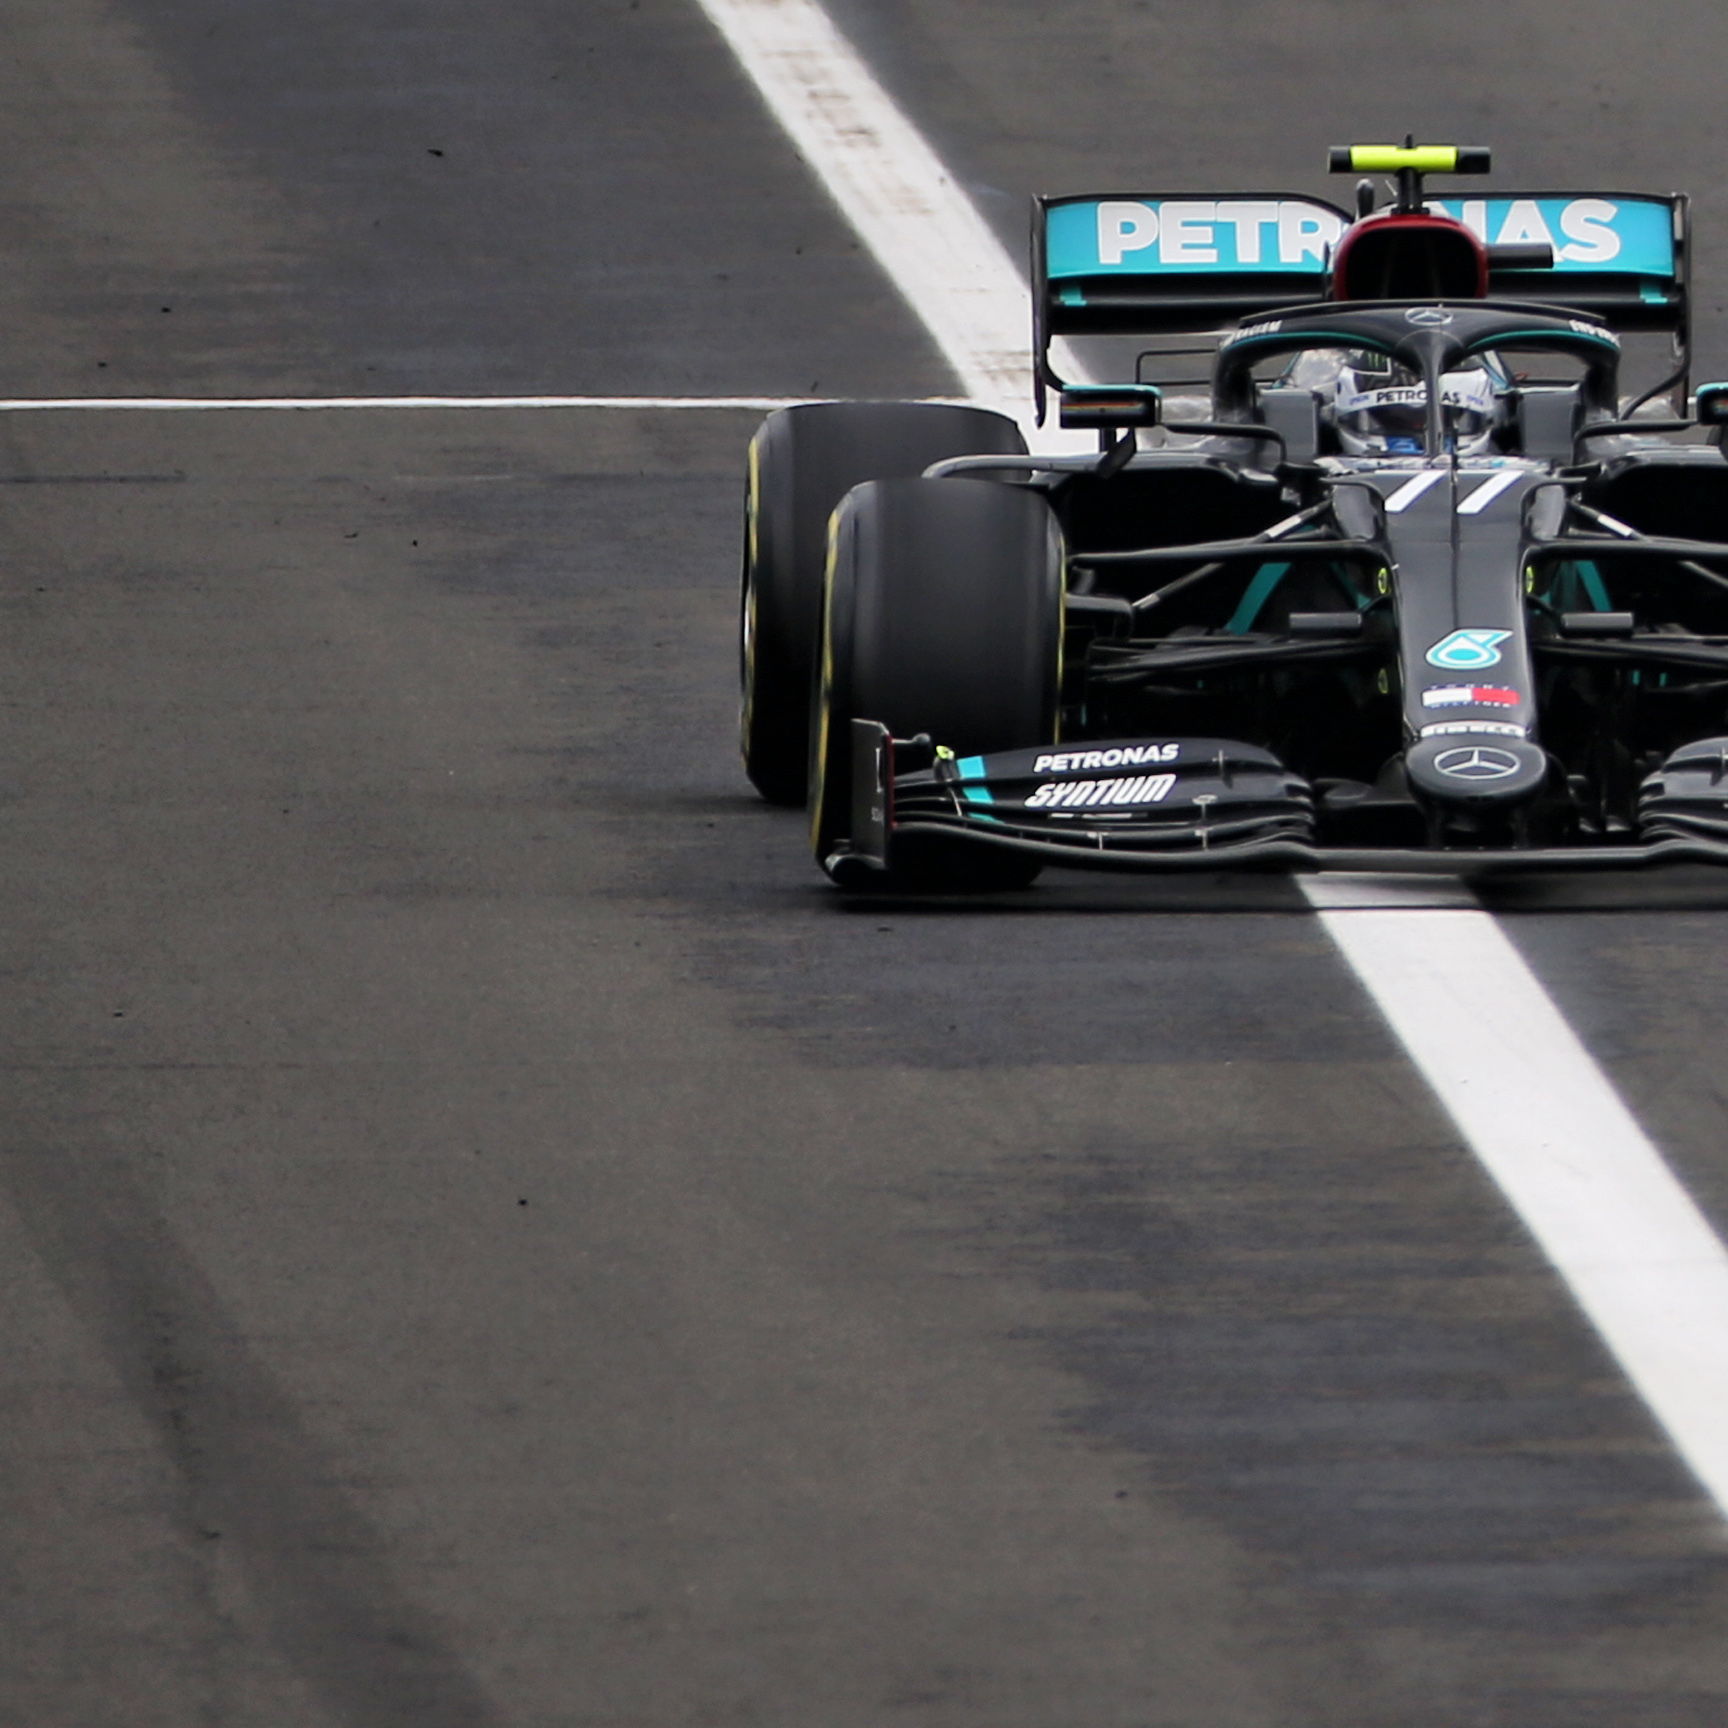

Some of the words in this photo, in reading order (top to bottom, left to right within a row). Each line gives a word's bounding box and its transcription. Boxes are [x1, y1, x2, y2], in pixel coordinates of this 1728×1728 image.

[1099, 198, 1622, 264] PETRAS
[1377, 389, 1460, 405] PETROAS
[1376, 468, 1524, 514] 77
[1033, 743, 1180, 773] PETRONAS
[1024, 774, 1177, 808] SYNTIUM
